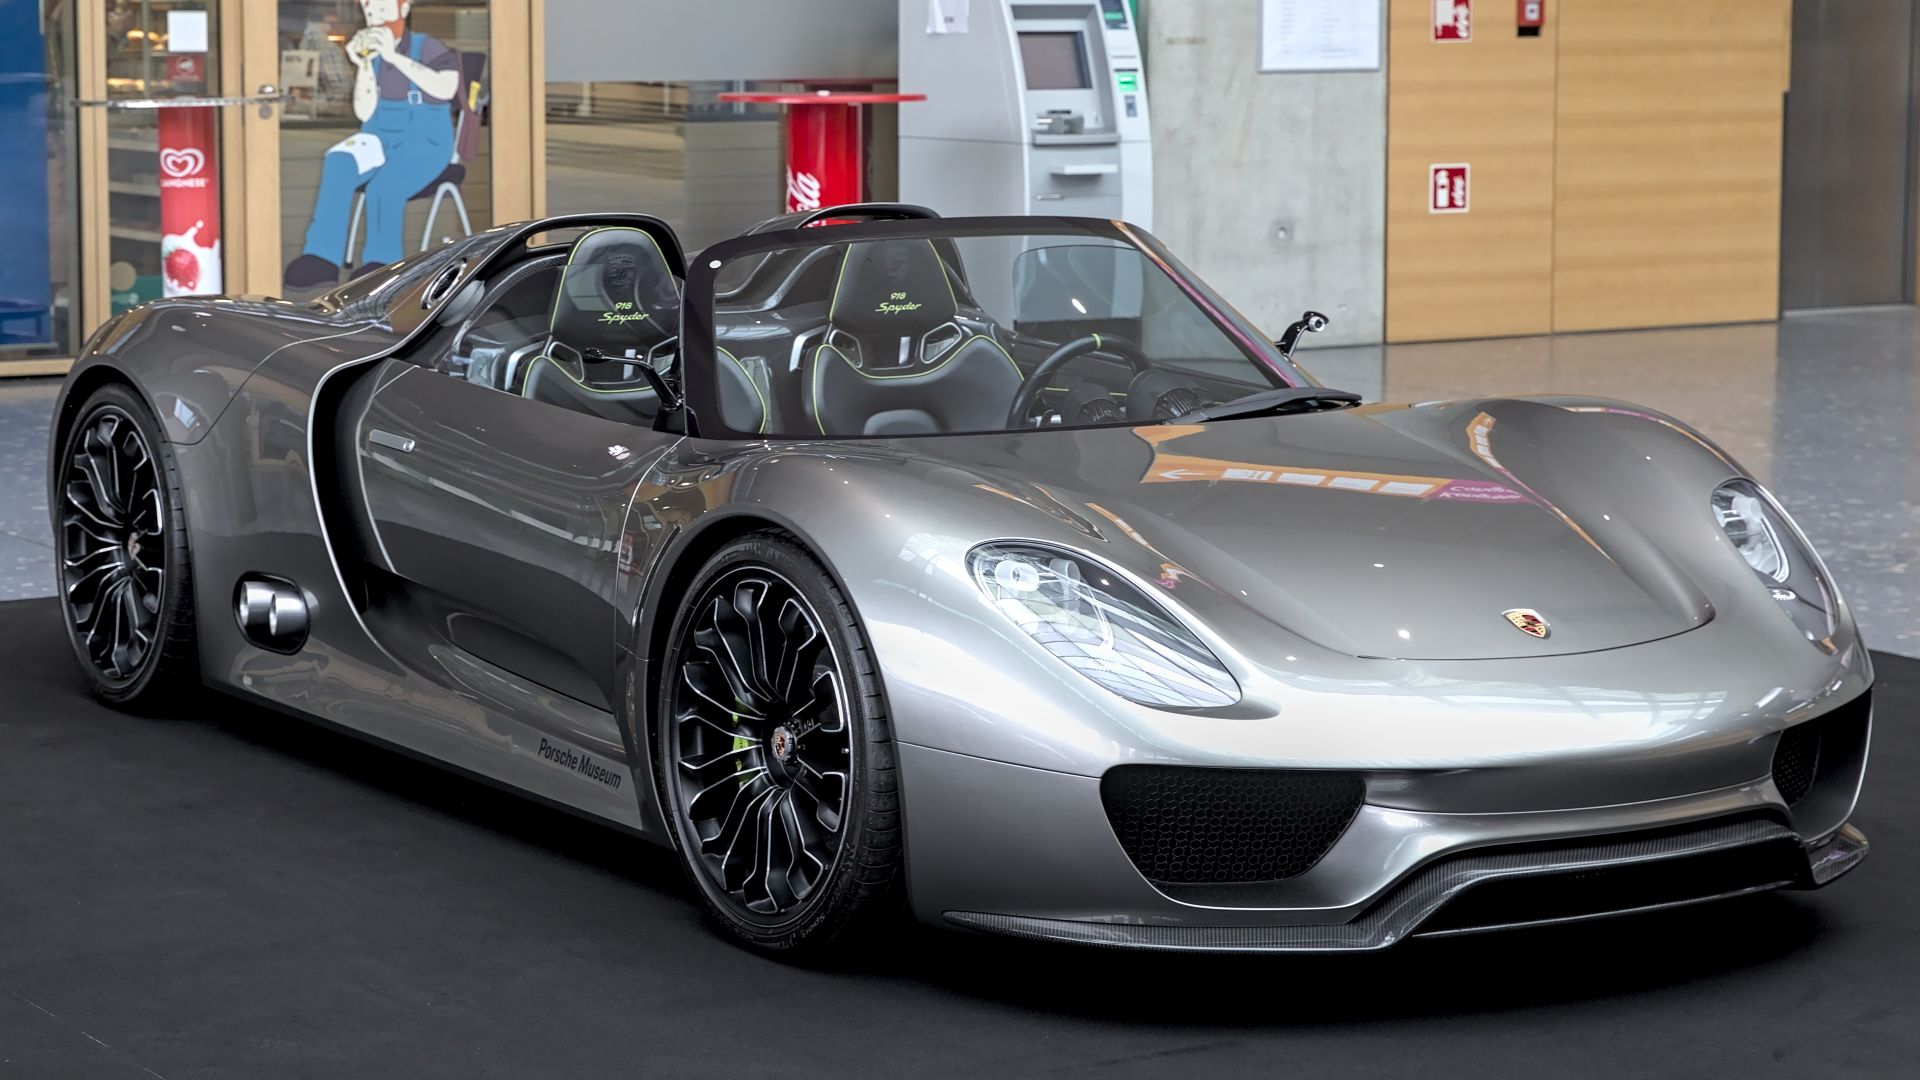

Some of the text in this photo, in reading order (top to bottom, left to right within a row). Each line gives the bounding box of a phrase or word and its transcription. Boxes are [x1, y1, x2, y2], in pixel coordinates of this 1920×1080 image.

[890, 292, 907, 300] 918
[614, 302, 632, 310] 918
[874, 301, 922, 315] Spyder
[597, 312, 650, 325] Spyder
[538, 737, 622, 789] Porsche Museum
